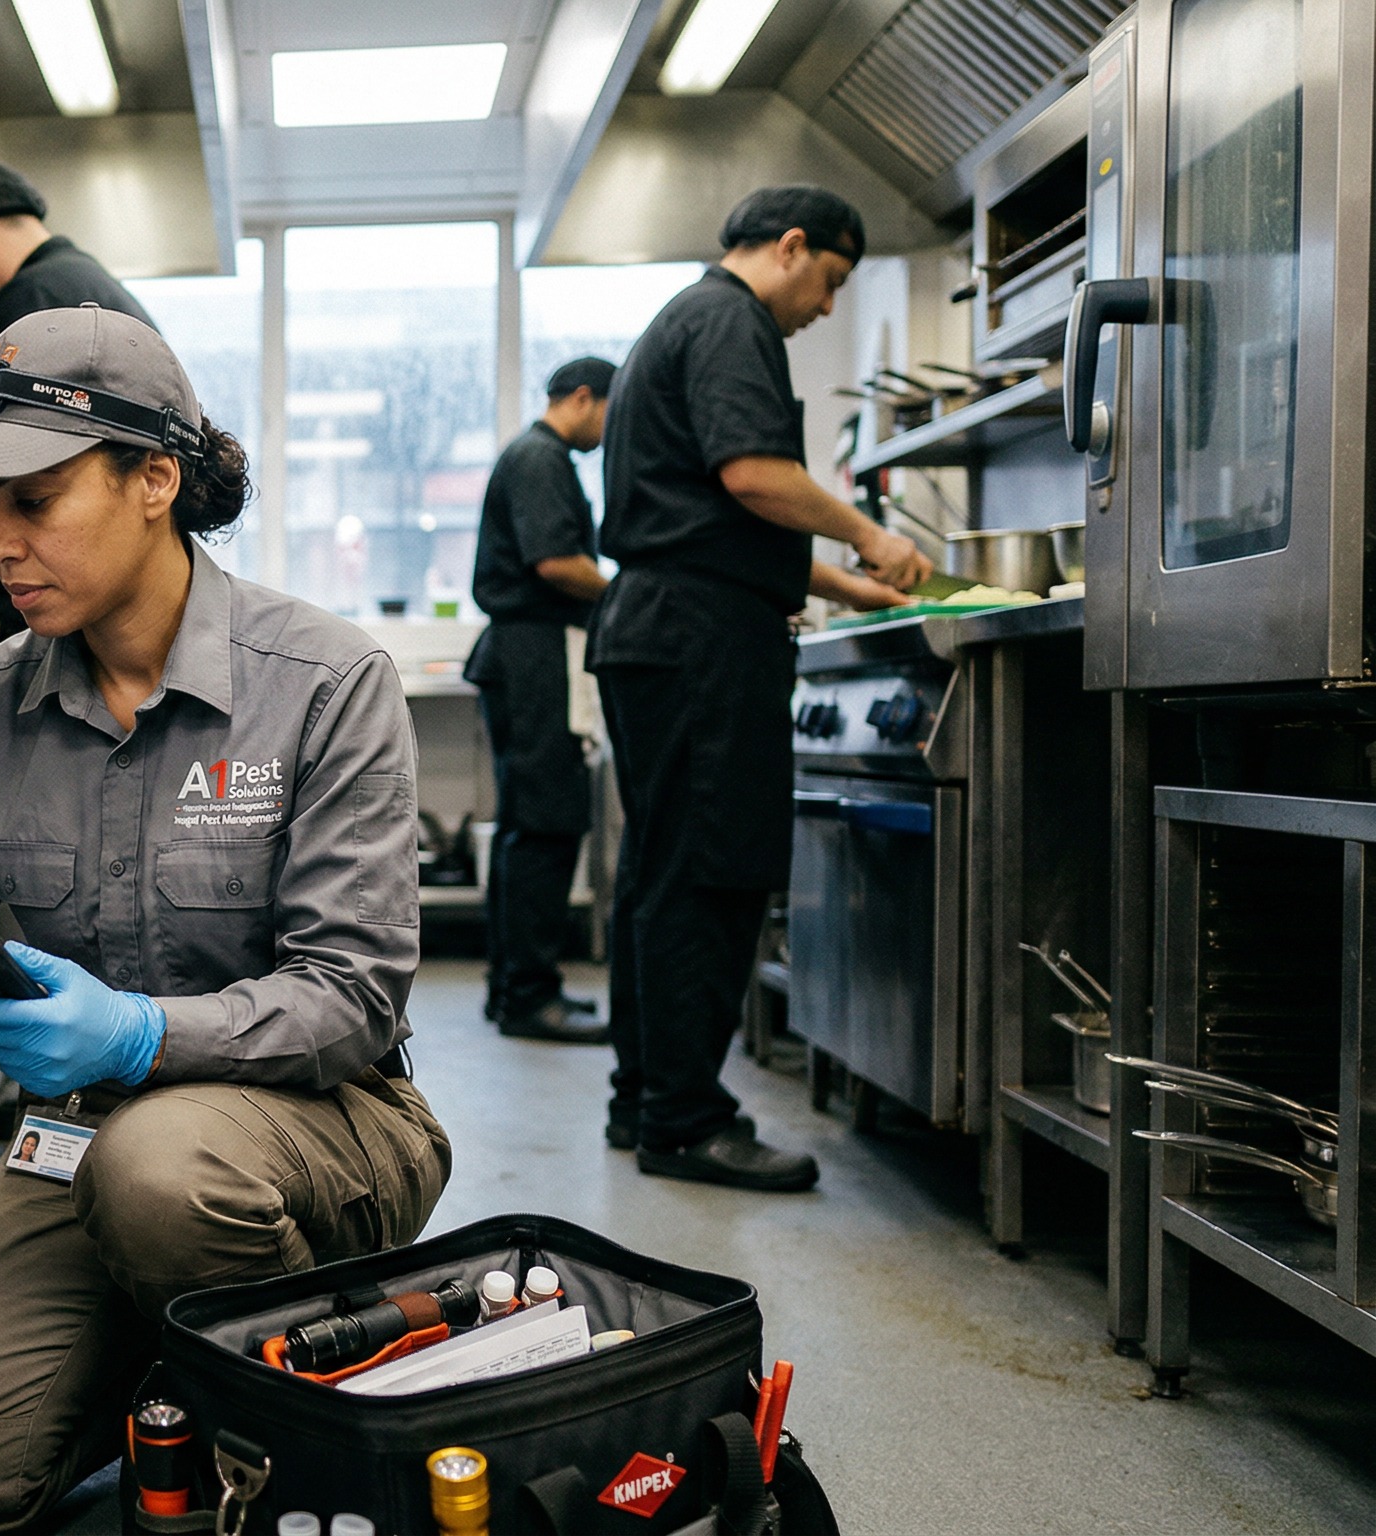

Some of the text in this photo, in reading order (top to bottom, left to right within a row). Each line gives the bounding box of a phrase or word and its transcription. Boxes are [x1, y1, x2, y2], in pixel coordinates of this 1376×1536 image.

[177, 757, 283, 799] A1 Pest
[614, 1467, 675, 1505] KNIPEX
